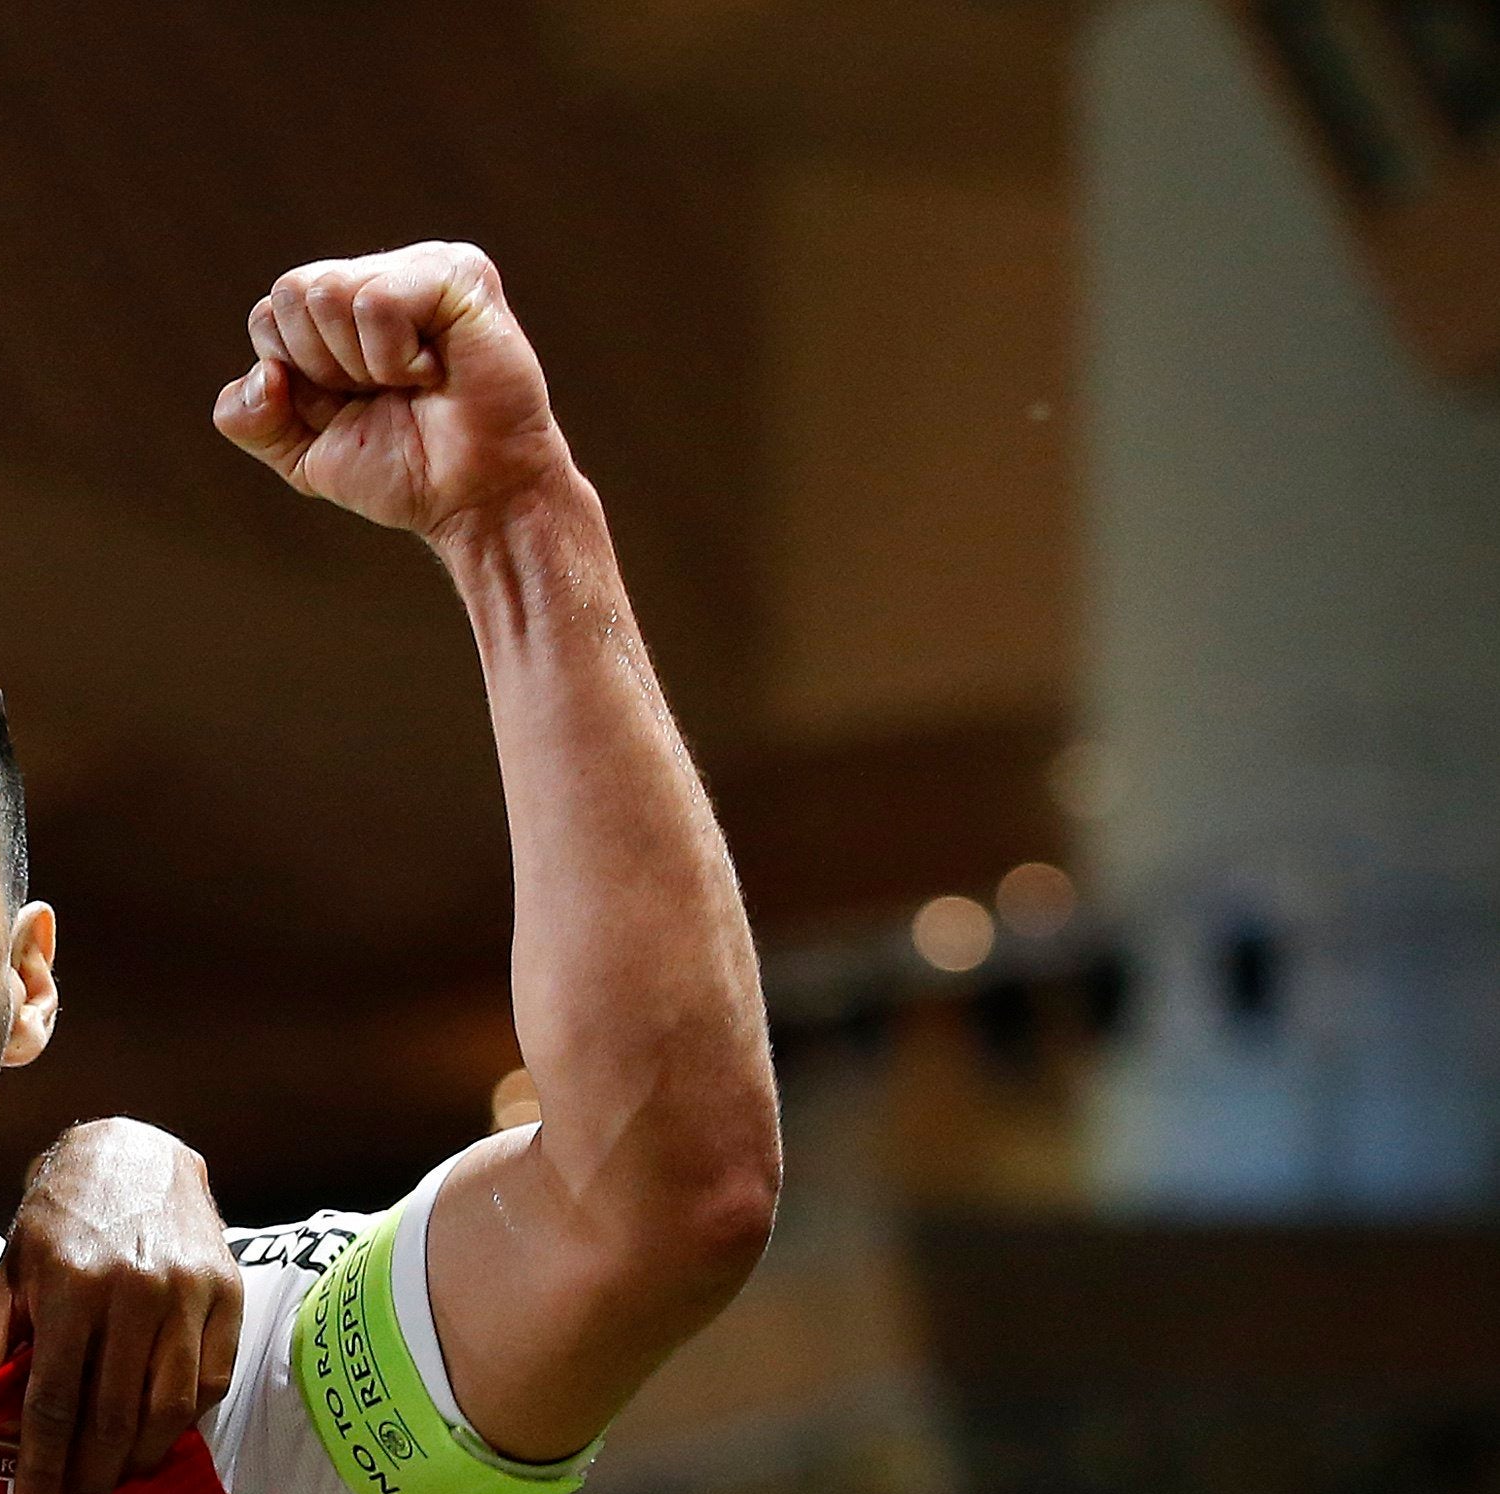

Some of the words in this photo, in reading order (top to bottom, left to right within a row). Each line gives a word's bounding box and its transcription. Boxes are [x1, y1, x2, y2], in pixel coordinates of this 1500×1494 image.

[314, 1264, 339, 1379] RACIS
[342, 1240, 383, 1409] RESPECT
[325, 1387, 353, 1440] TO
[353, 1444, 401, 1494] NO
